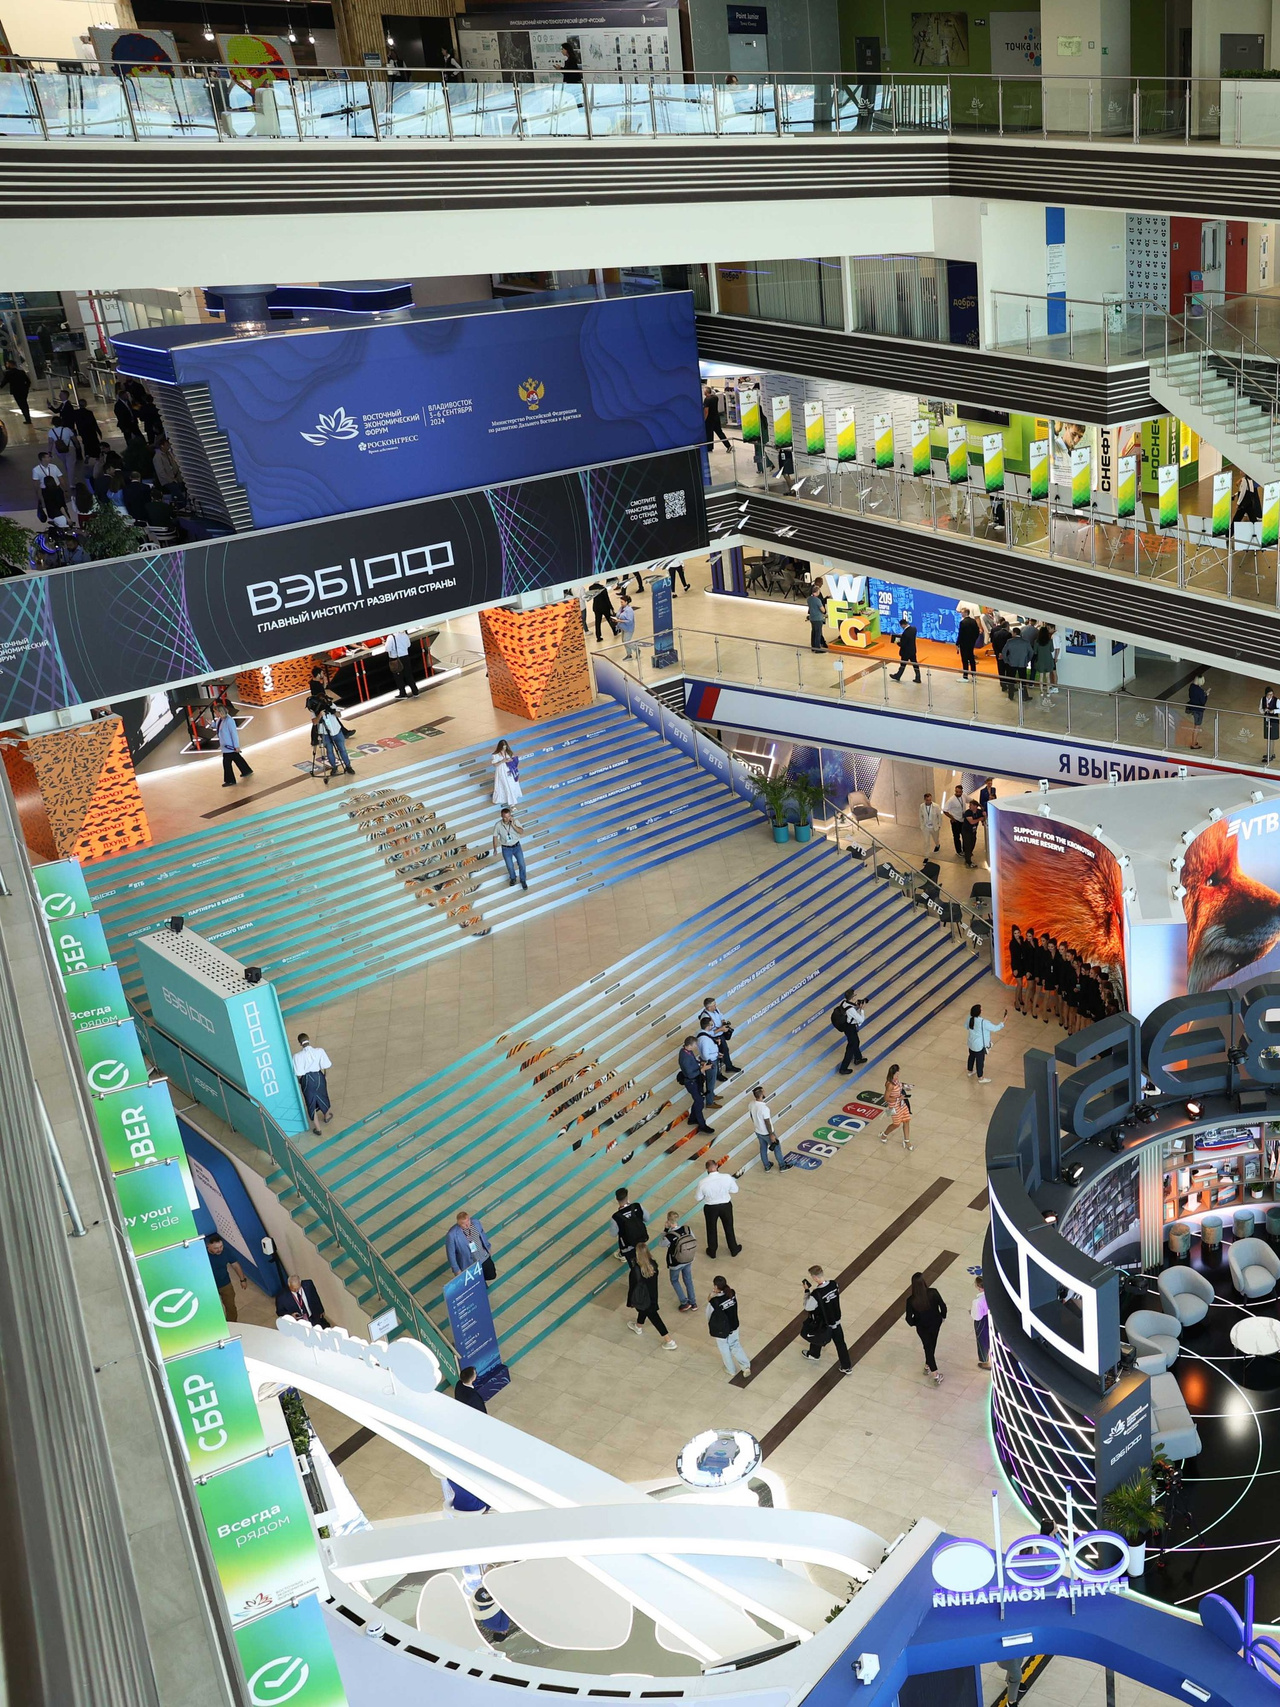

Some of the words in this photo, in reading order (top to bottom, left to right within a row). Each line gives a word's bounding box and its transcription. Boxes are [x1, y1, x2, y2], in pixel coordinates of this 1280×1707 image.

[1005, 41, 1031, 52] точка
[428, 399, 473, 412] ВЛАДИВОСТОК
[442, 406, 473, 417] СЕНТЯБРЯ
[362, 409, 402, 421] ВОСТОЧНЫЙ
[364, 414, 420, 429] ЭКОНОМИЧЕСКИЙ
[430, 418, 445, 426] 2024
[491, 416, 524, 427] Министерство
[525, 412, 551, 423] Российской
[551, 408, 577, 418] Федерации
[365, 427, 389, 436] ФОРУМ
[495, 424, 518, 433] развитию
[518, 420, 542, 430] Дальнего
[542, 417, 558, 426] Востока
[367, 435, 419, 448] РОСКОНГРЕСС
[625, 503, 657, 516] ТРАНСЛЯЦИИ
[630, 496, 657, 507] СМОТРИТЕ
[639, 509, 658, 520] СТЕНДА
[643, 516, 659, 526] ЗДЕСЬ
[662, 579, 671, 588] A5
[825, 573, 868, 603] W
[257, 612, 310, 634] ГЛАВНЫЙ
[310, 600, 365, 622] ИНСТИТУТ
[367, 588, 418, 608] РАЗВИТИЯ
[418, 577, 457, 597] СТРАНЫ
[878, 591, 893, 605] 209
[827, 599, 855, 628] F
[839, 616, 871, 650] G
[0, 637, 29, 649] ТОЧНЫЙ
[640, 701, 654, 717] ВТБ
[673, 727, 688, 743] ВТБ
[708, 754, 723, 770] ВТБ
[1059, 754, 1071, 774] Я
[1240, 812, 1280, 840] VTB
[103, 836, 131, 849] ПХУКЕТ
[1013, 826, 1042, 839] SUPPORT
[1043, 830, 1055, 841] FOR
[1055, 834, 1066, 845] THE
[1066, 839, 1095, 859] KRONOTSKY
[1014, 835, 1040, 848] NATURE
[1040, 840, 1065, 853] RESERVE
[133, 881, 145, 889] ВТБ
[888, 870, 905, 886] ВТБ
[188, 903, 216, 916] ПАРТНЕРЫ
[221, 893, 245, 905] БИЗНЕСЕ
[927, 898, 944, 915] ВТБ
[237, 922, 253, 933] ТИГРА
[966, 929, 983, 946] ВТБ
[726, 977, 751, 997] ПАРТНЕРЫ
[756, 960, 776, 979] БИЗНЕСЕ
[751, 999, 780, 1022] ПОДДЕРЖКЕ
[780, 981, 806, 1006] АМУРСКОГО
[806, 970, 820, 983] ТИГРА
[827, 1126, 854, 1144] C
[810, 1139, 838, 1157] B
[141, 1205, 173, 1223] your
[150, 1216, 180, 1231] side
[464, 1261, 482, 1287] A4
[183, 1374, 228, 1452] СБЕР
[217, 1503, 281, 1539] Всегда
[236, 1515, 290, 1548] рядом
